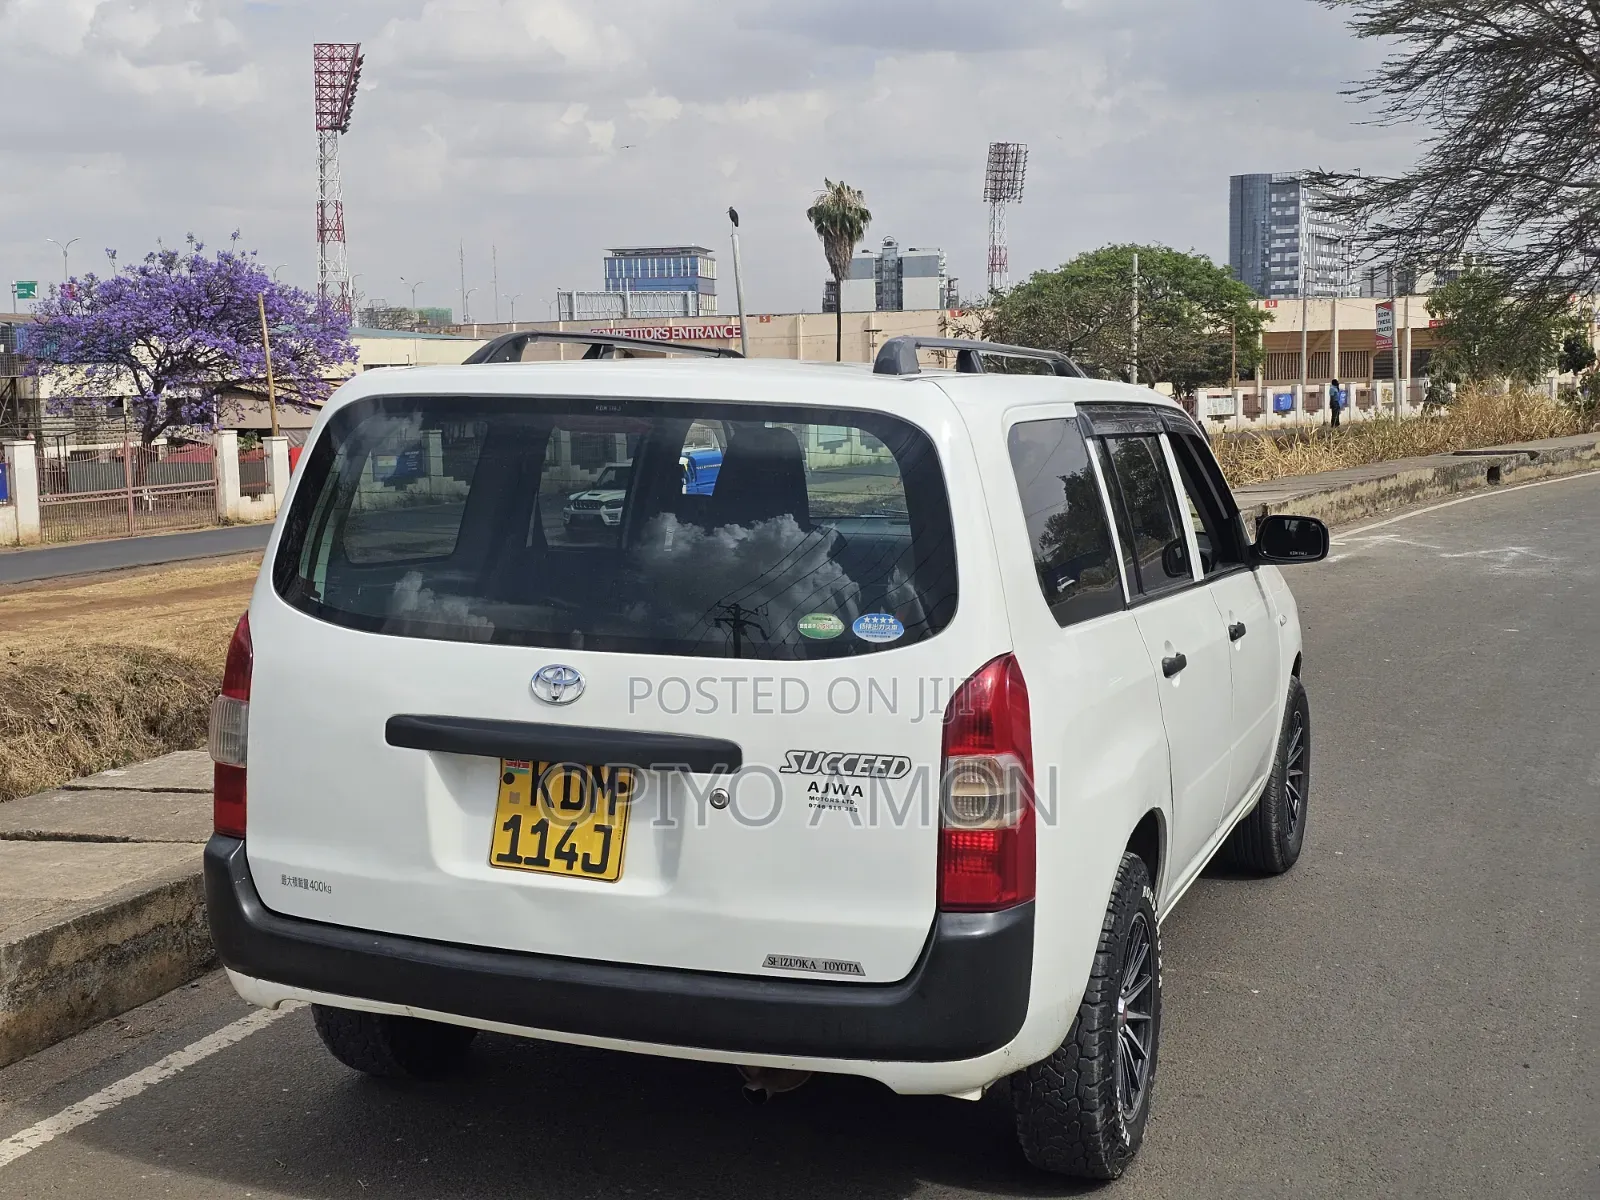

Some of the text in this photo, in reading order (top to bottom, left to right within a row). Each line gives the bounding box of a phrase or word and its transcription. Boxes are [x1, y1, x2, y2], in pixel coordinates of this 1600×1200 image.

[671, 325, 741, 339] ENTRANCE
[779, 749, 912, 779] SUCCEED
[530, 761, 618, 816] KDM
[807, 781, 864, 797] AJWA
[496, 814, 613, 874] 114J
[822, 961, 860, 973] TOYOTA
